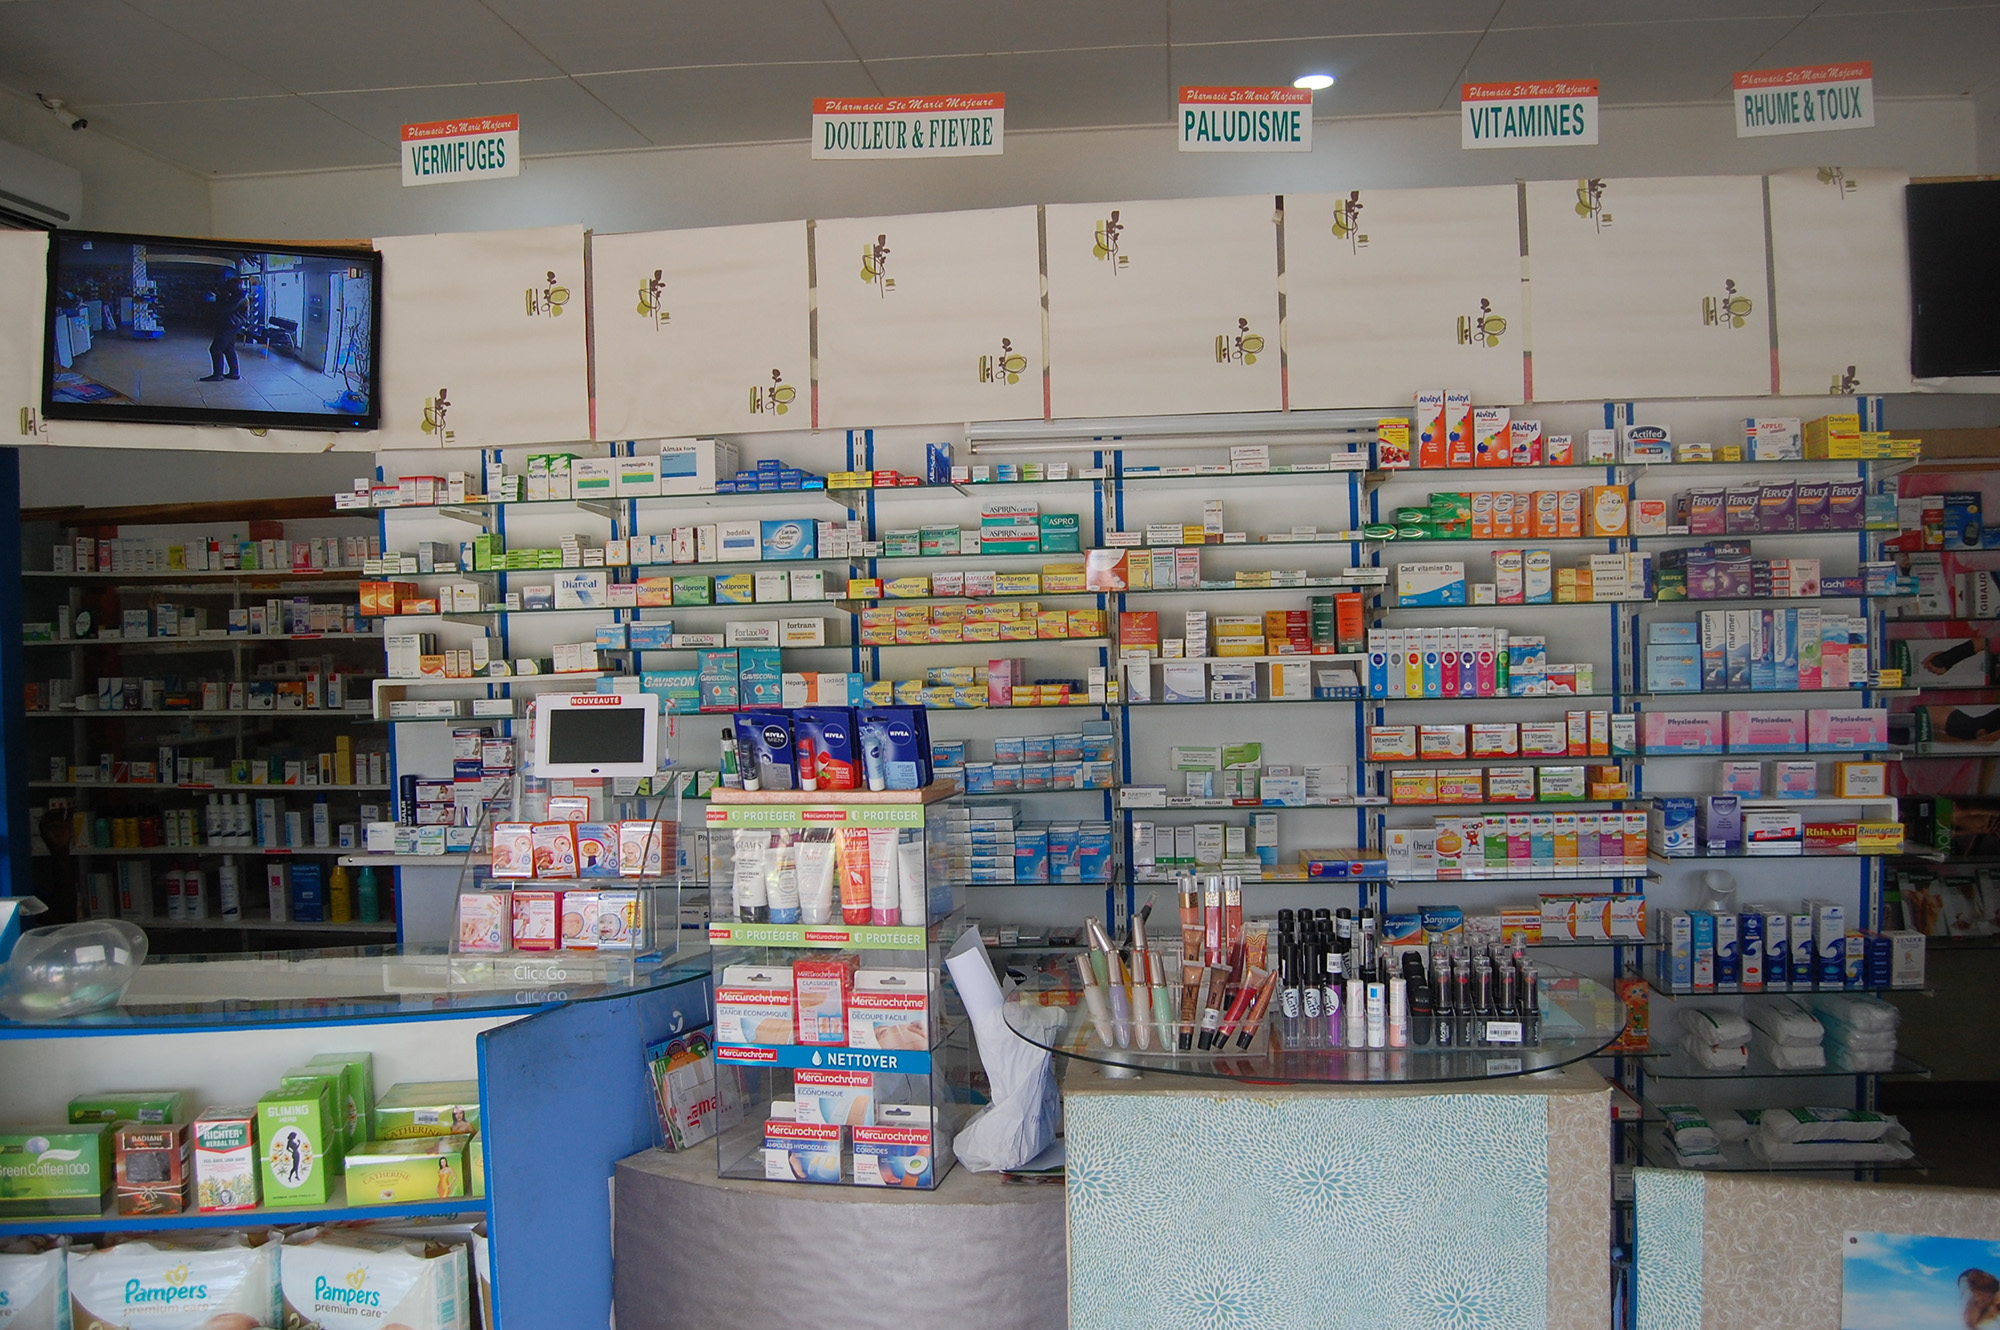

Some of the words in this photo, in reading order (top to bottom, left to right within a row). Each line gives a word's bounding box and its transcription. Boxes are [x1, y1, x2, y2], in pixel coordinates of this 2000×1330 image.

[1741, 74, 1784, 85] Pharmacie
[1785, 72, 1799, 82] Ste
[1801, 70, 1827, 80] Marie
[1828, 68, 1863, 79] Majeure
[1187, 90, 1227, 101] Pharmacie
[1229, 91, 1243, 101] Ste
[1244, 90, 1269, 100] Marie
[1270, 90, 1303, 102] Majeure
[1469, 87, 1511, 98] Pharmacie
[1513, 86, 1527, 96] Ste
[1528, 85, 1554, 95] Marie
[1555, 84, 1590, 95] Majeure
[825, 101, 884, 112] Pharmacie
[886, 101, 907, 110] Ste
[908, 99, 944, 109] Marie
[946, 98, 994, 108] Majeure
[1744, 92, 1800, 127] RHUME
[1804, 91, 1815, 122] &
[1817, 87, 1861, 121] TOUX
[1185, 110, 1300, 142] PALUDISME
[1470, 103, 1584, 139] VITAMINES
[408, 127, 444, 138] Pharmacie
[445, 124, 458, 134] Ste
[459, 122, 481, 132] Marie
[481, 120, 511, 131] Majeure
[824, 120, 907, 150] DOULEUR
[912, 120, 924, 148] &
[929, 117, 993, 148] FIEVRE
[412, 138, 505, 175] VERMIFUGES
[1419, 395, 1442, 403] Alvityl
[1447, 394, 1469, 402] Alvityl
[1475, 410, 1497, 418] Alvityl
[1511, 422, 1537, 431] Alvityl
[1632, 430, 1663, 439] Actifed
[1549, 436, 1568, 445] Alvityl
[1762, 488, 1793, 498] FERVEX
[1798, 487, 1829, 497] FERVEX
[1831, 486, 1863, 496] FERVEX
[1692, 495, 1724, 506] FERVEX
[1728, 495, 1759, 505] FERVEX
[989, 505, 1017, 513] ASPIRIN
[1049, 518, 1074, 526] ASPRO
[989, 530, 1016, 538] ASPIRIN
[562, 580, 597, 589] Diareal
[638, 585, 669, 593] Doliprane
[674, 584, 706, 592] Doliprane
[716, 582, 749, 591] Doliprane
[897, 610, 925, 619] Doliprane
[984, 606, 1014, 615] Doliprane
[787, 621, 816, 630] fortrans
[1001, 624, 1031, 633] Doliprane
[735, 628, 757, 637] forlax
[864, 630, 893, 638] Doliprane
[930, 628, 960, 636] Doliprane
[681, 635, 703, 643] forlax
[741, 672, 769, 681] GAVISCON
[644, 676, 695, 688] GAVISCON
[571, 696, 621, 705] NOUVEAUTÉ
[923, 692, 952, 700] Doliprane
[1668, 718, 1708, 726] Physiodose
[1374, 736, 1397, 744] Vitamine
[1849, 773, 1878, 783] Sinuspax
[1396, 787, 1410, 795] 500
[1442, 786, 1456, 794] 500
[744, 809, 796, 821] PROTÉGER
[864, 809, 918, 821] PROTÉGER
[843, 829, 867, 837] Mixa
[1806, 827, 1855, 837] RhinAdvil
[1858, 826, 1902, 835] RHUMAGRIP
[1387, 845, 1409, 856] Orocal
[1413, 840, 1434, 851] Orocal
[1384, 920, 1416, 928] Sargenor
[1424, 915, 1460, 924] Sargenor
[747, 930, 799, 940] PROTÉGER
[866, 932, 920, 944] PROTÉGER
[514, 966, 566, 980] Clic&Go
[719, 991, 789, 1004] Mercurochrome
[851, 994, 923, 1008] Mercurochrome
[1284, 992, 1297, 1017] Matte
[1304, 991, 1318, 1016] Matte
[719, 1048, 774, 1059] Mercurochrome
[828, 1053, 897, 1068] NETTOYER
[797, 1072, 869, 1085] Mercurochrome
[267, 1105, 308, 1117] SLIMING
[768, 1124, 838, 1138] Mercurochrome
[856, 1130, 929, 1143] Mercurochrome
[28, 1163, 63, 1176] Coffee
[65, 1163, 89, 1175] 1000
[363, 1171, 410, 1184] CATHERINE
[125, 1277, 207, 1303] Pampers
[315, 1276, 380, 1307] Pampers
[124, 1303, 179, 1316] premium
[184, 1303, 209, 1313] care
[315, 1303, 358, 1315] premium
[360, 1307, 382, 1317] care
